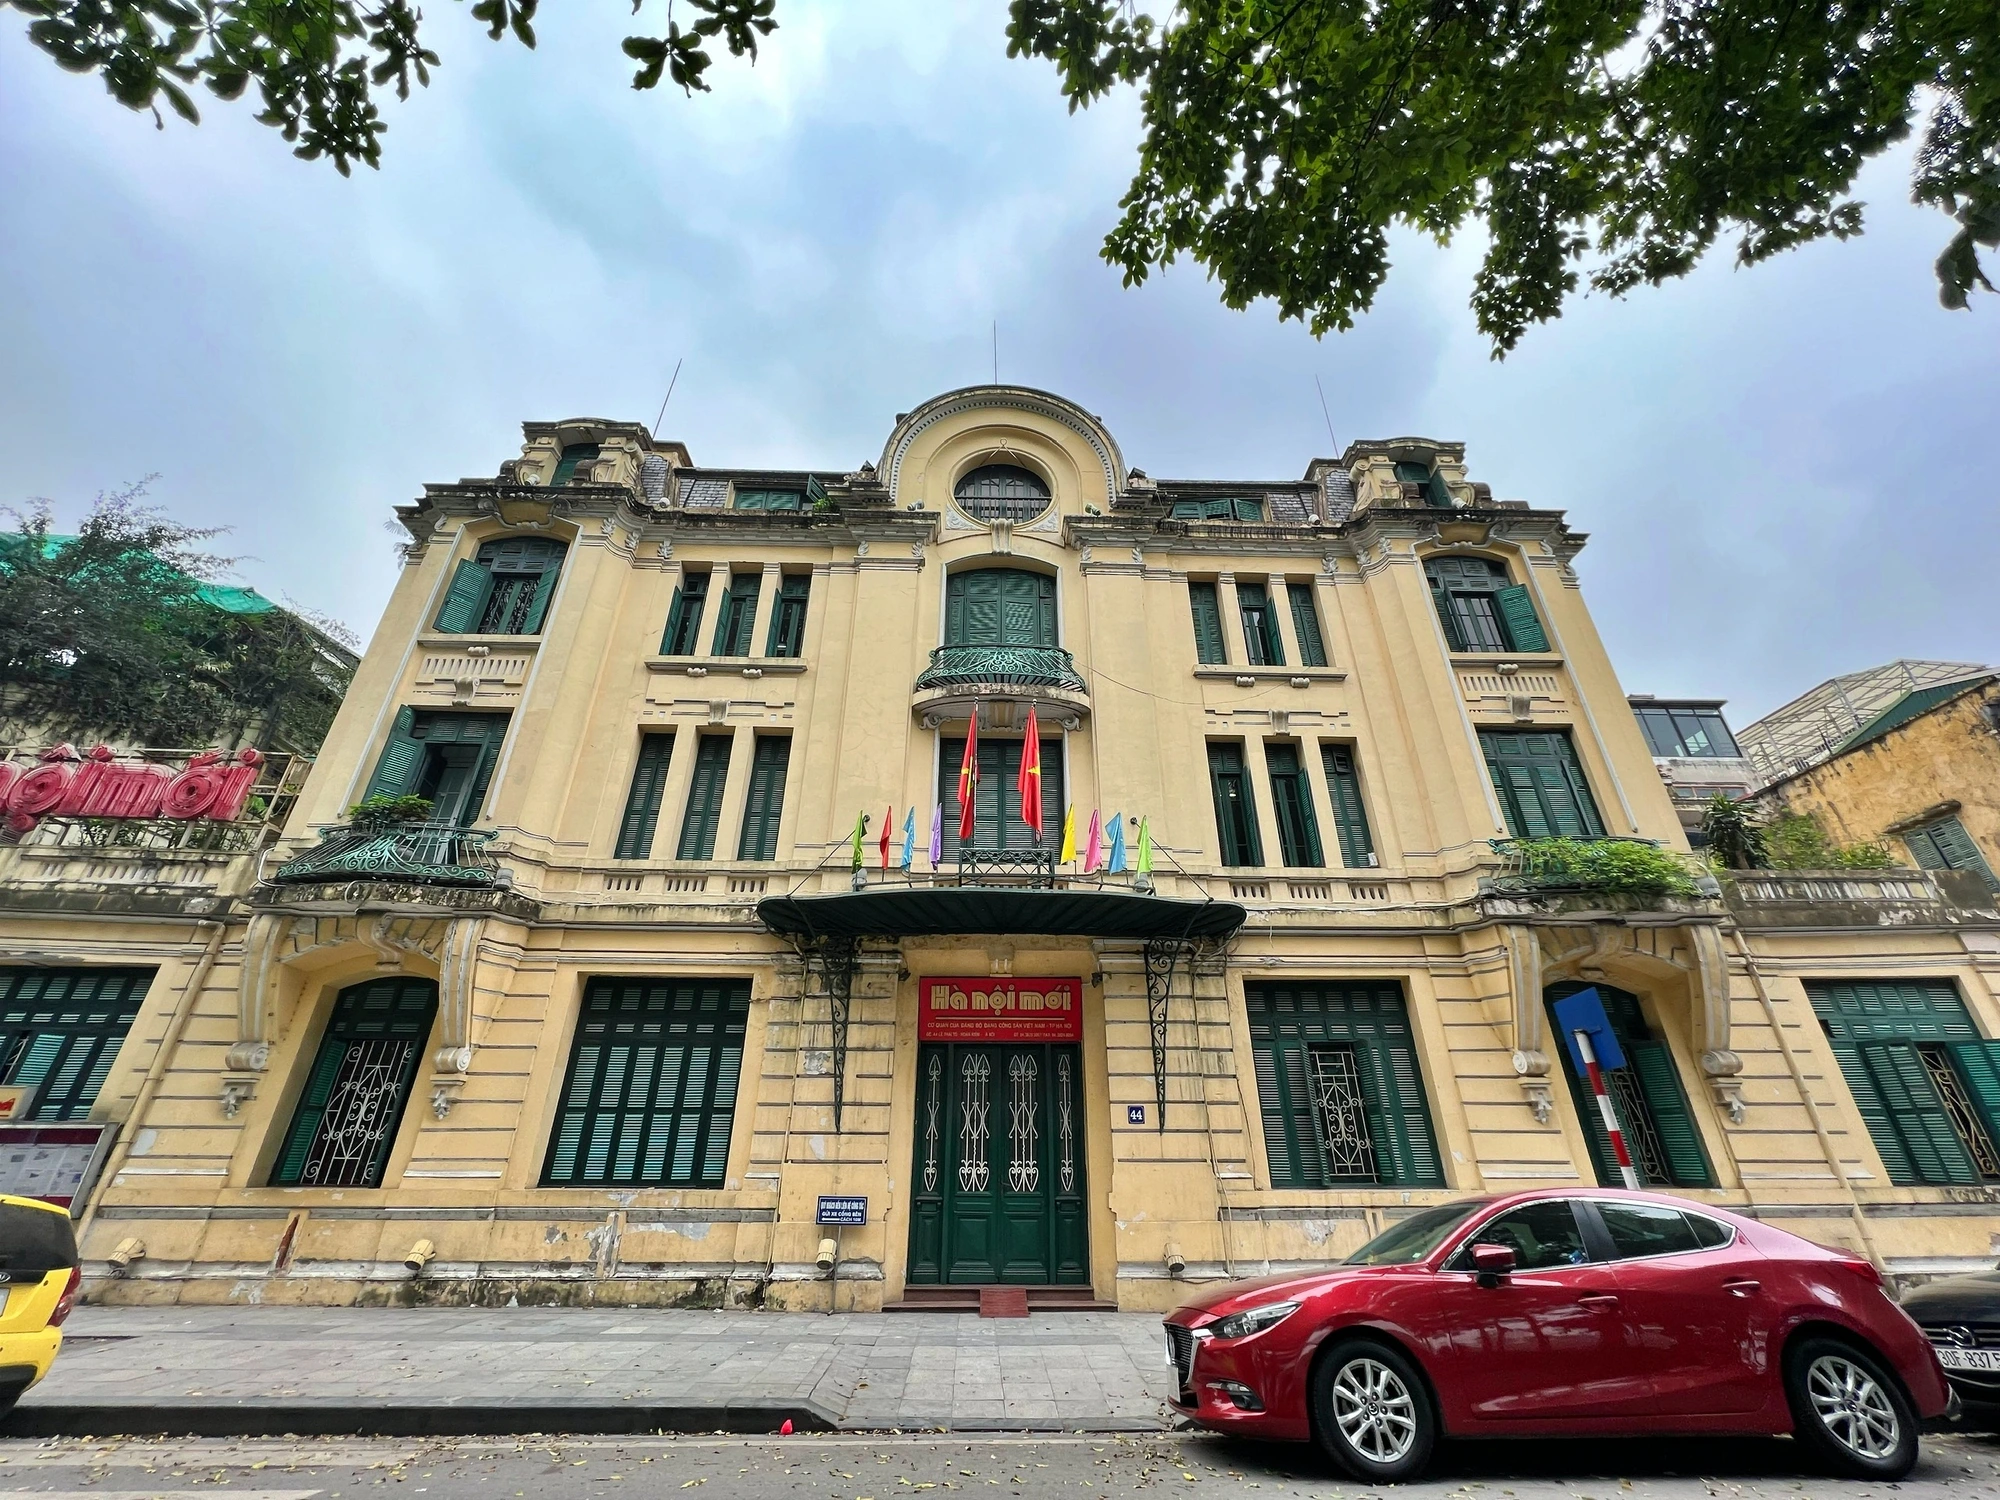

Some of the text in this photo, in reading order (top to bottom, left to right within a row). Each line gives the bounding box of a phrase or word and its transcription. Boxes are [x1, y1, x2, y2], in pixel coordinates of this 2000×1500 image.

[931, 984, 1071, 1016] Hà nội mới
[1130, 1110, 1143, 1120] 44
